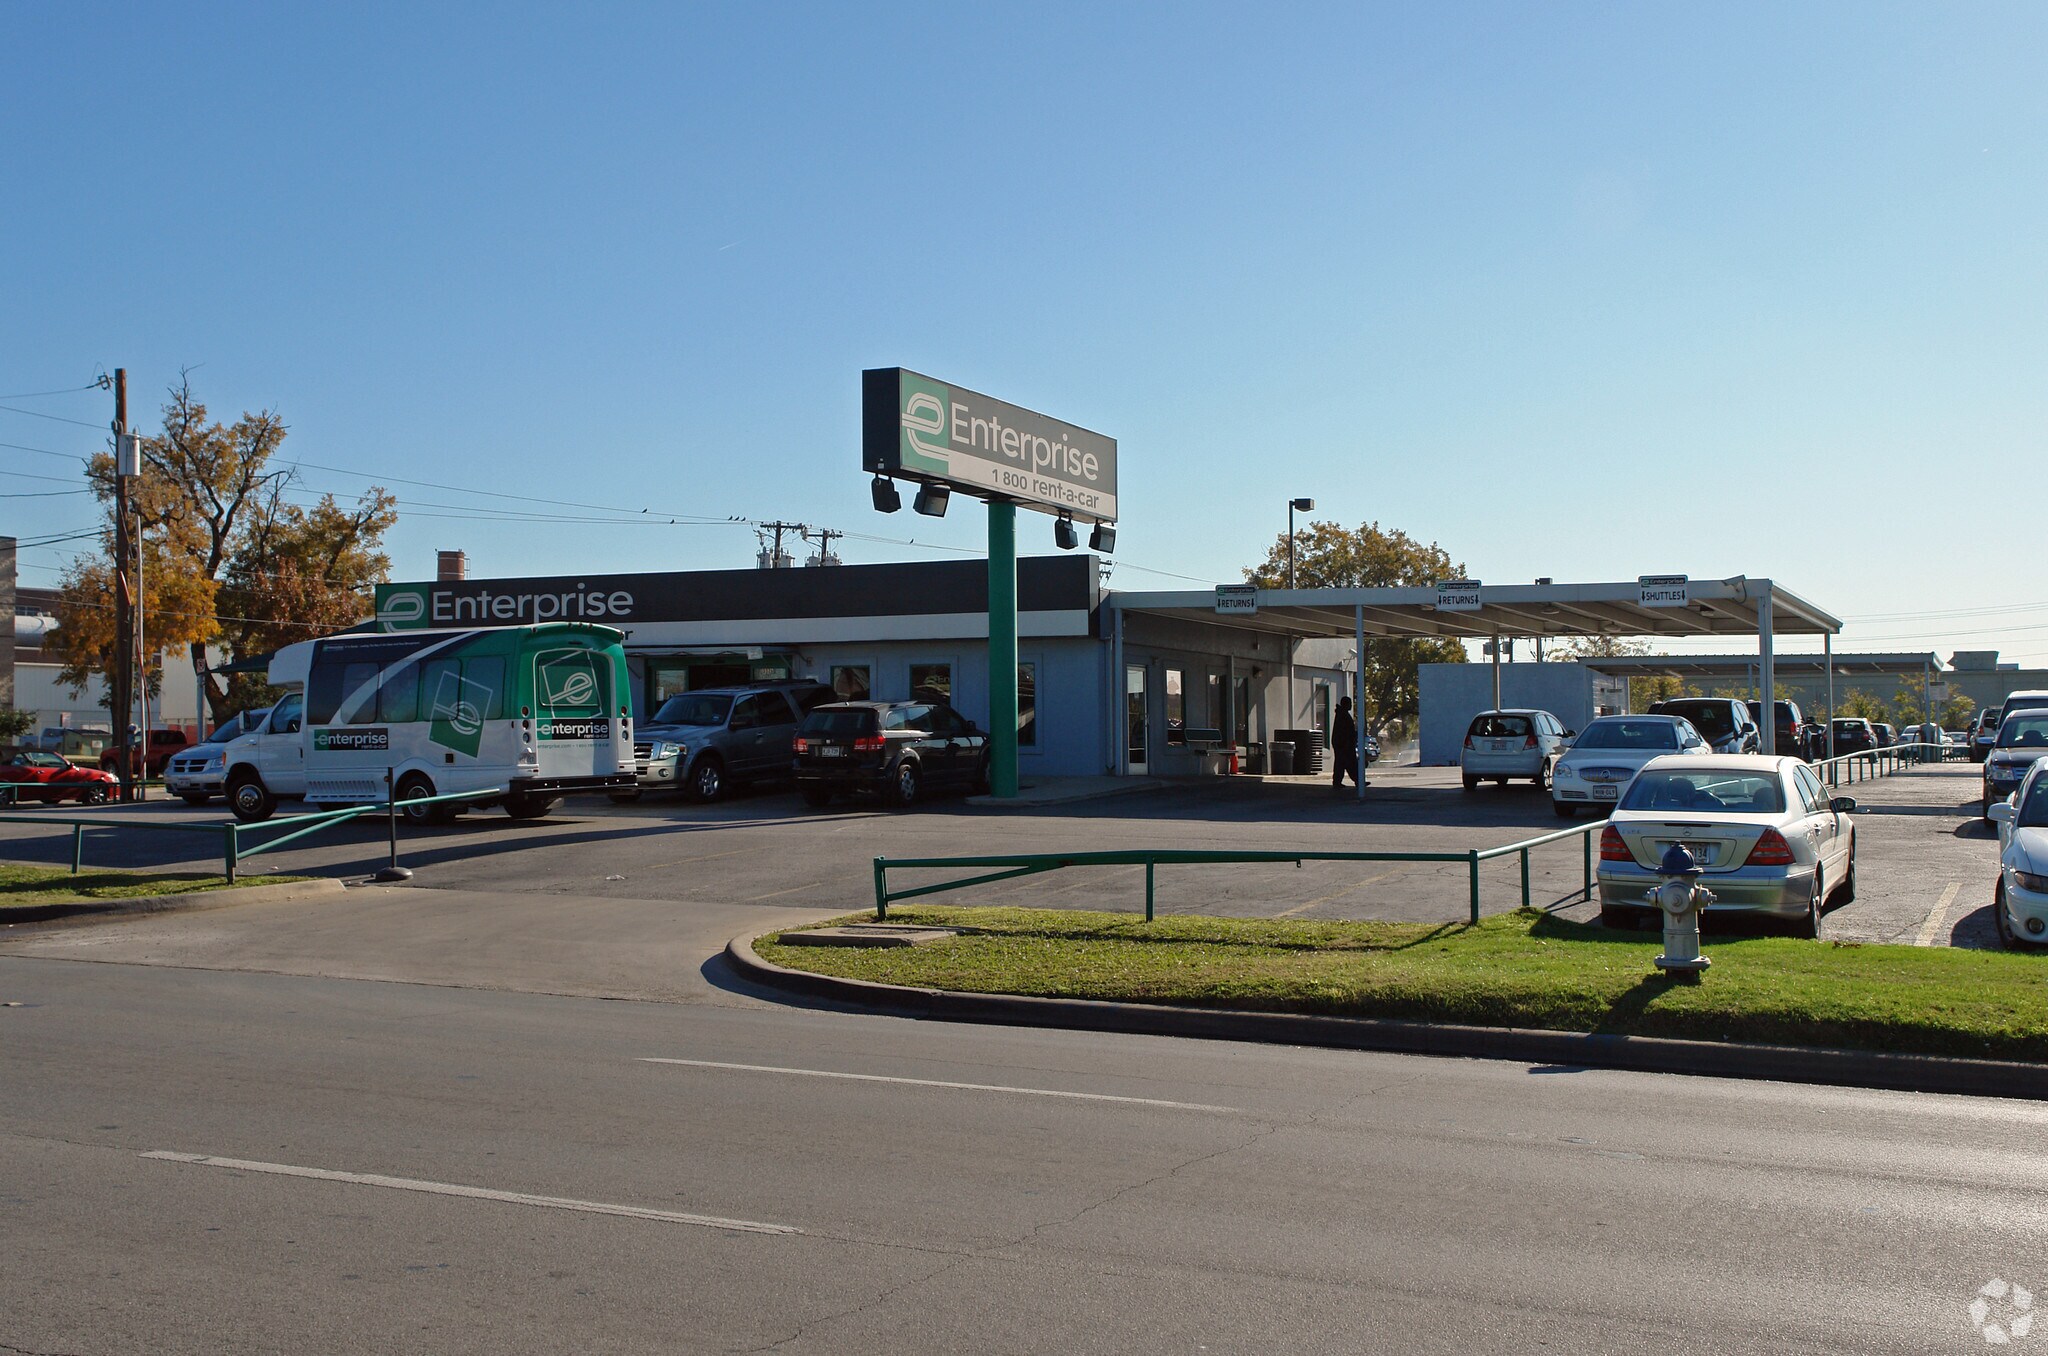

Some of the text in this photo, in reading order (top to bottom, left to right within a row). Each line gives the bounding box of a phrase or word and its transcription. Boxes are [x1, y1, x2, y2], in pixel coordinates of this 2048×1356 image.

[951, 402, 1099, 481] Enterprise
[992, 468, 1099, 509] 1 800 rent-a-car
[432, 582, 634, 624] Enterprise
[1221, 599, 1251, 608] RETURNS
[1442, 595, 1475, 605] RETURNS
[1646, 591, 1681, 600] SHUTTLES
[537, 722, 608, 737] enterprise
[315, 731, 388, 748] enterprise
